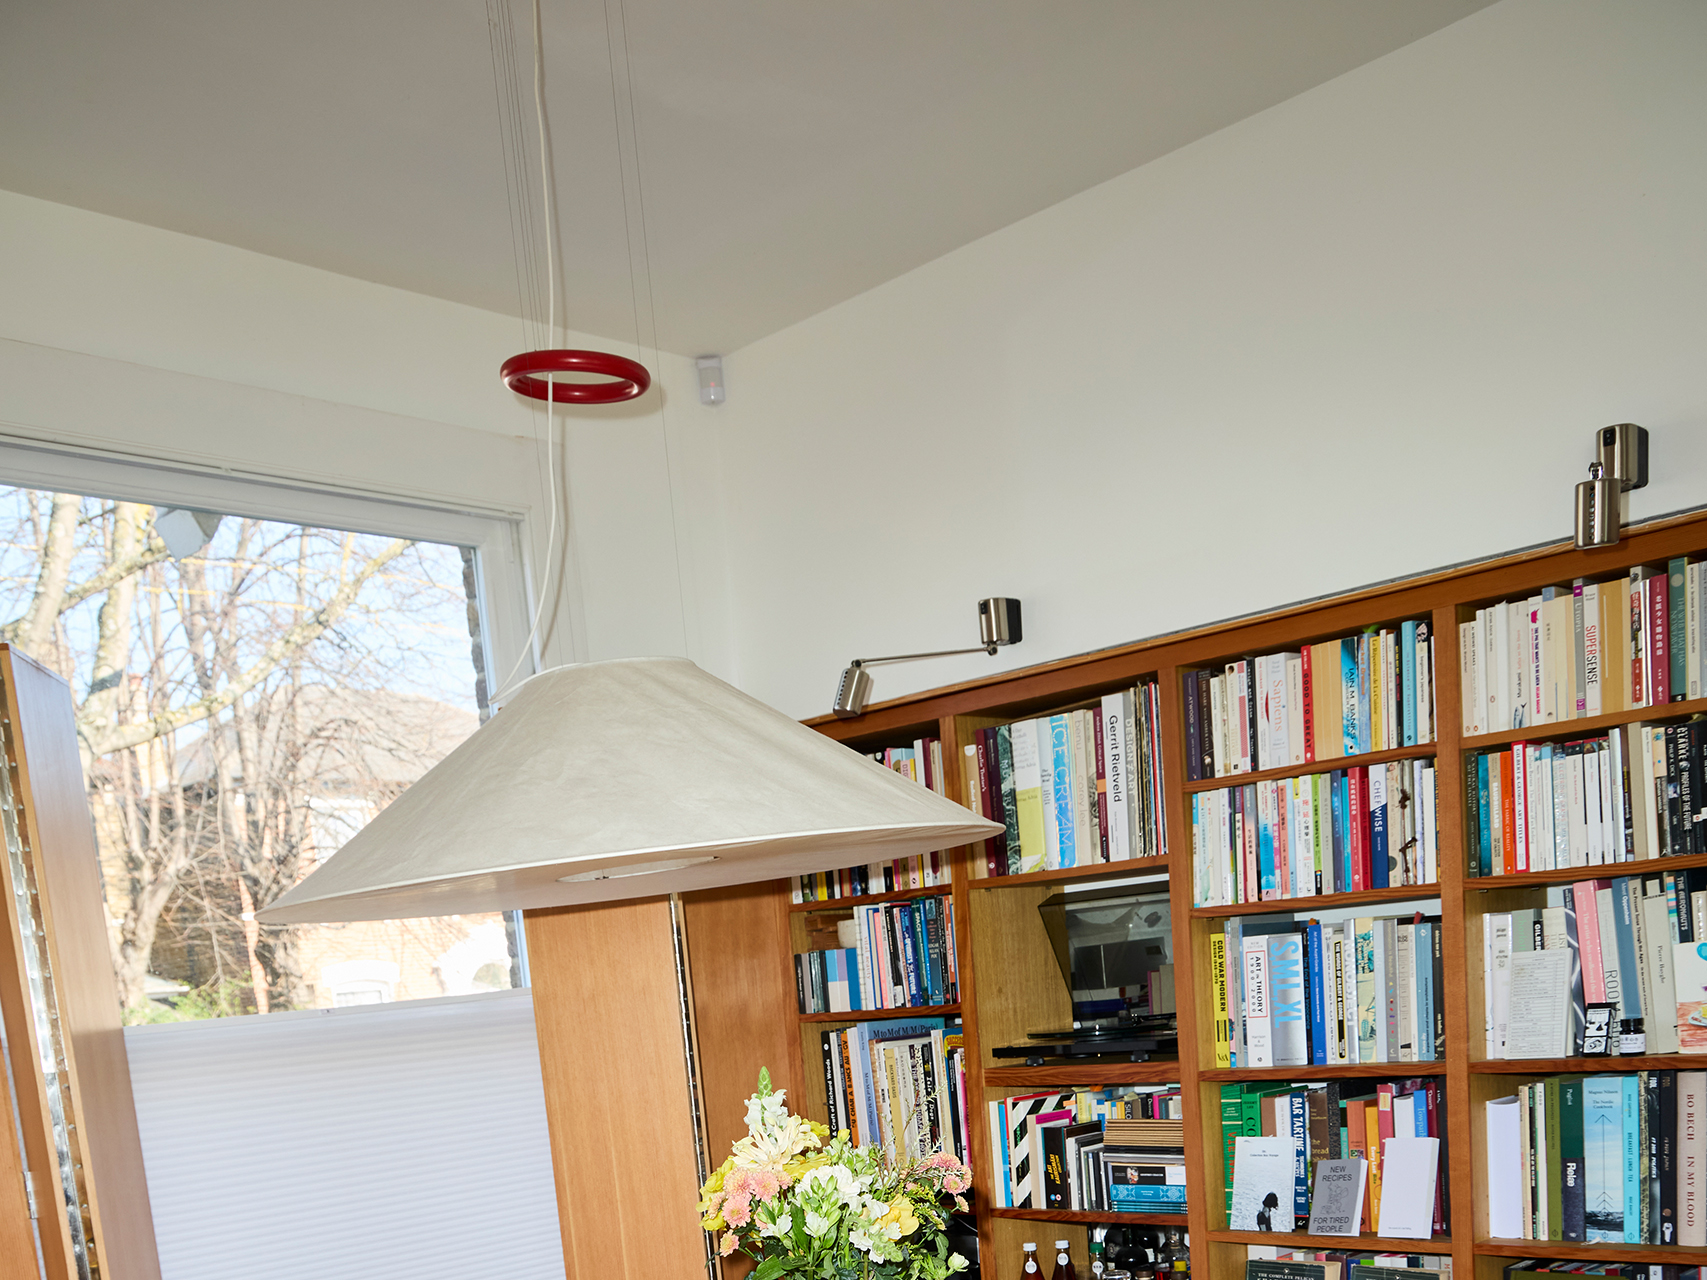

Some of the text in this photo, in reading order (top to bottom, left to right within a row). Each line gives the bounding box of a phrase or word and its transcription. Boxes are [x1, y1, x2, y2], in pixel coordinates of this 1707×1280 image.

[1372, 639, 1377, 647] Le
[1585, 625, 1598, 685] SUPERSENSE
[1270, 680, 1285, 731] Sapiens
[1305, 703, 1310, 714] TO
[1108, 715, 1122, 802] Gerrit Rietveld
[1125, 719, 1135, 796] DESIGN ART
[1050, 722, 1072, 847] ICE CREAM
[1681, 772, 1690, 794] PROFILES
[1079, 809, 1088, 826] lee
[1492, 782, 1500, 828] BAUDRILLARD
[1683, 812, 1692, 830] FUTURE
[1678, 891, 1688, 931] AERONAUTS
[1583, 925, 1591, 939] artist
[1269, 941, 1302, 1028] S,M,L,XL
[1344, 939, 1356, 1027] NONOBJECT
[1586, 954, 1595, 983] swallowed
[1686, 1094, 1694, 1108] BO
[1292, 1098, 1304, 1152] BAR TARTINE
[1322, 1174, 1352, 1182] RECIPES
[1687, 1156, 1694, 1168] IN
[1687, 1172, 1695, 1187] MY
[1687, 1191, 1695, 1227] BLOOD
